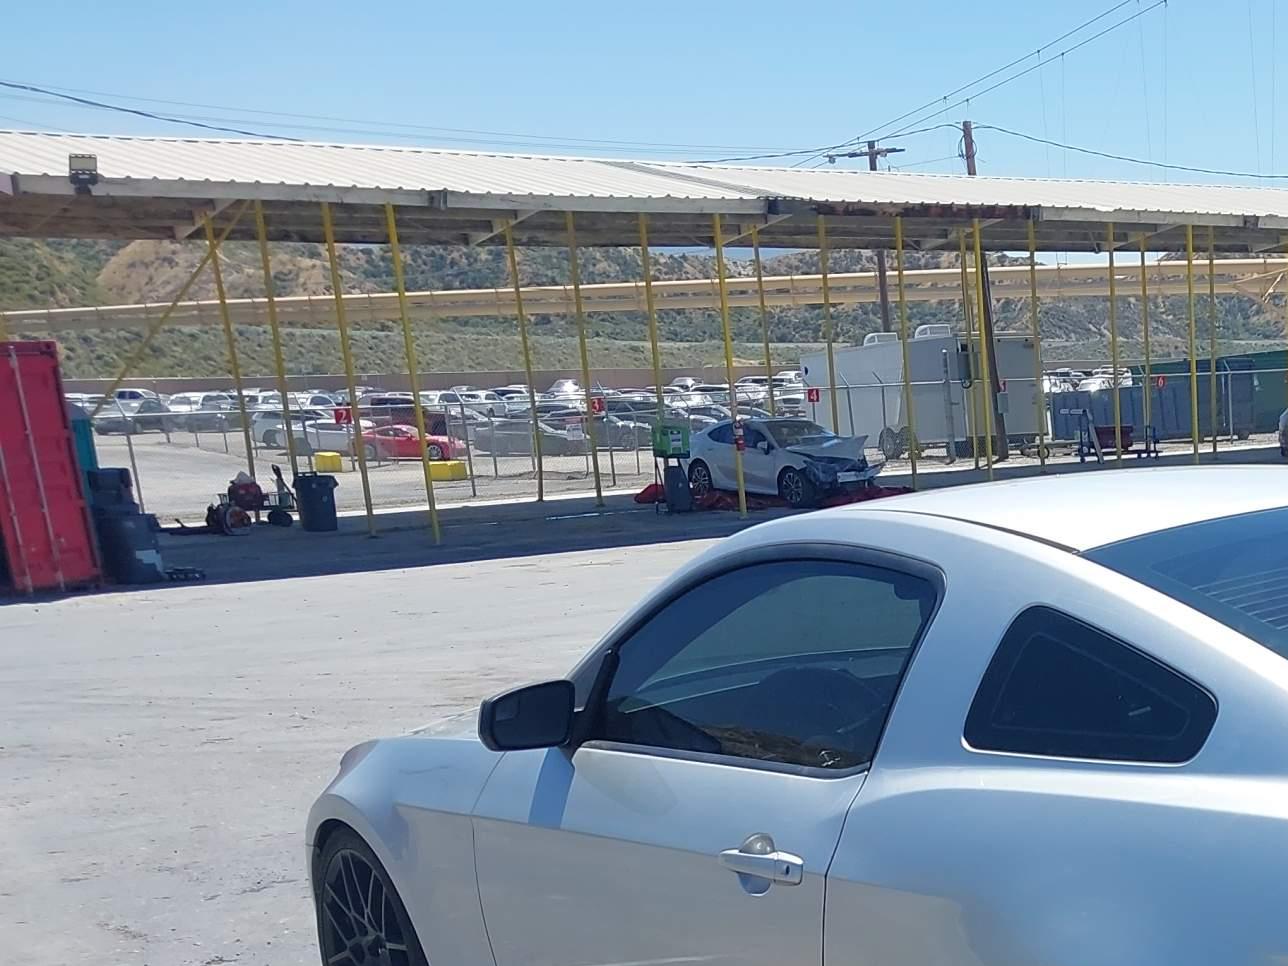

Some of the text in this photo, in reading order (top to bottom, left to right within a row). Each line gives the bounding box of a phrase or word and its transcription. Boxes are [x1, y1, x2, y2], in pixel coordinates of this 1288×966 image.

[810, 389, 818, 401] 4
[591, 398, 600, 412] 3
[338, 409, 348, 423] 2
